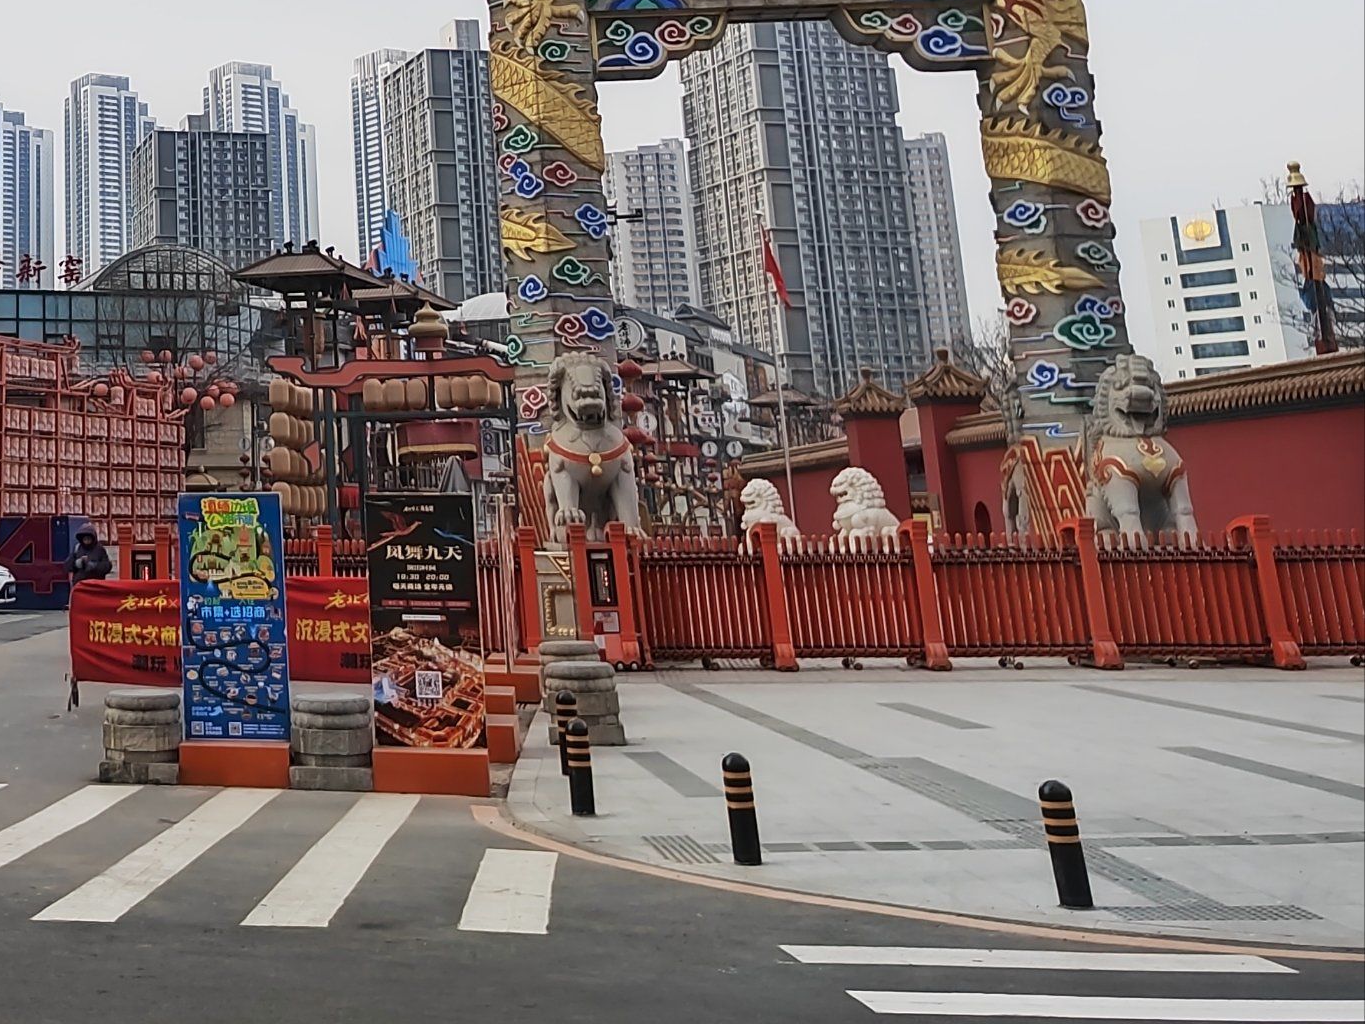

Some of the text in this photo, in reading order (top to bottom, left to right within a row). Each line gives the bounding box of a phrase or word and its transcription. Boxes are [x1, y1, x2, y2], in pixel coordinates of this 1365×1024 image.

[89, 620, 181, 647] 沉浸式文商
